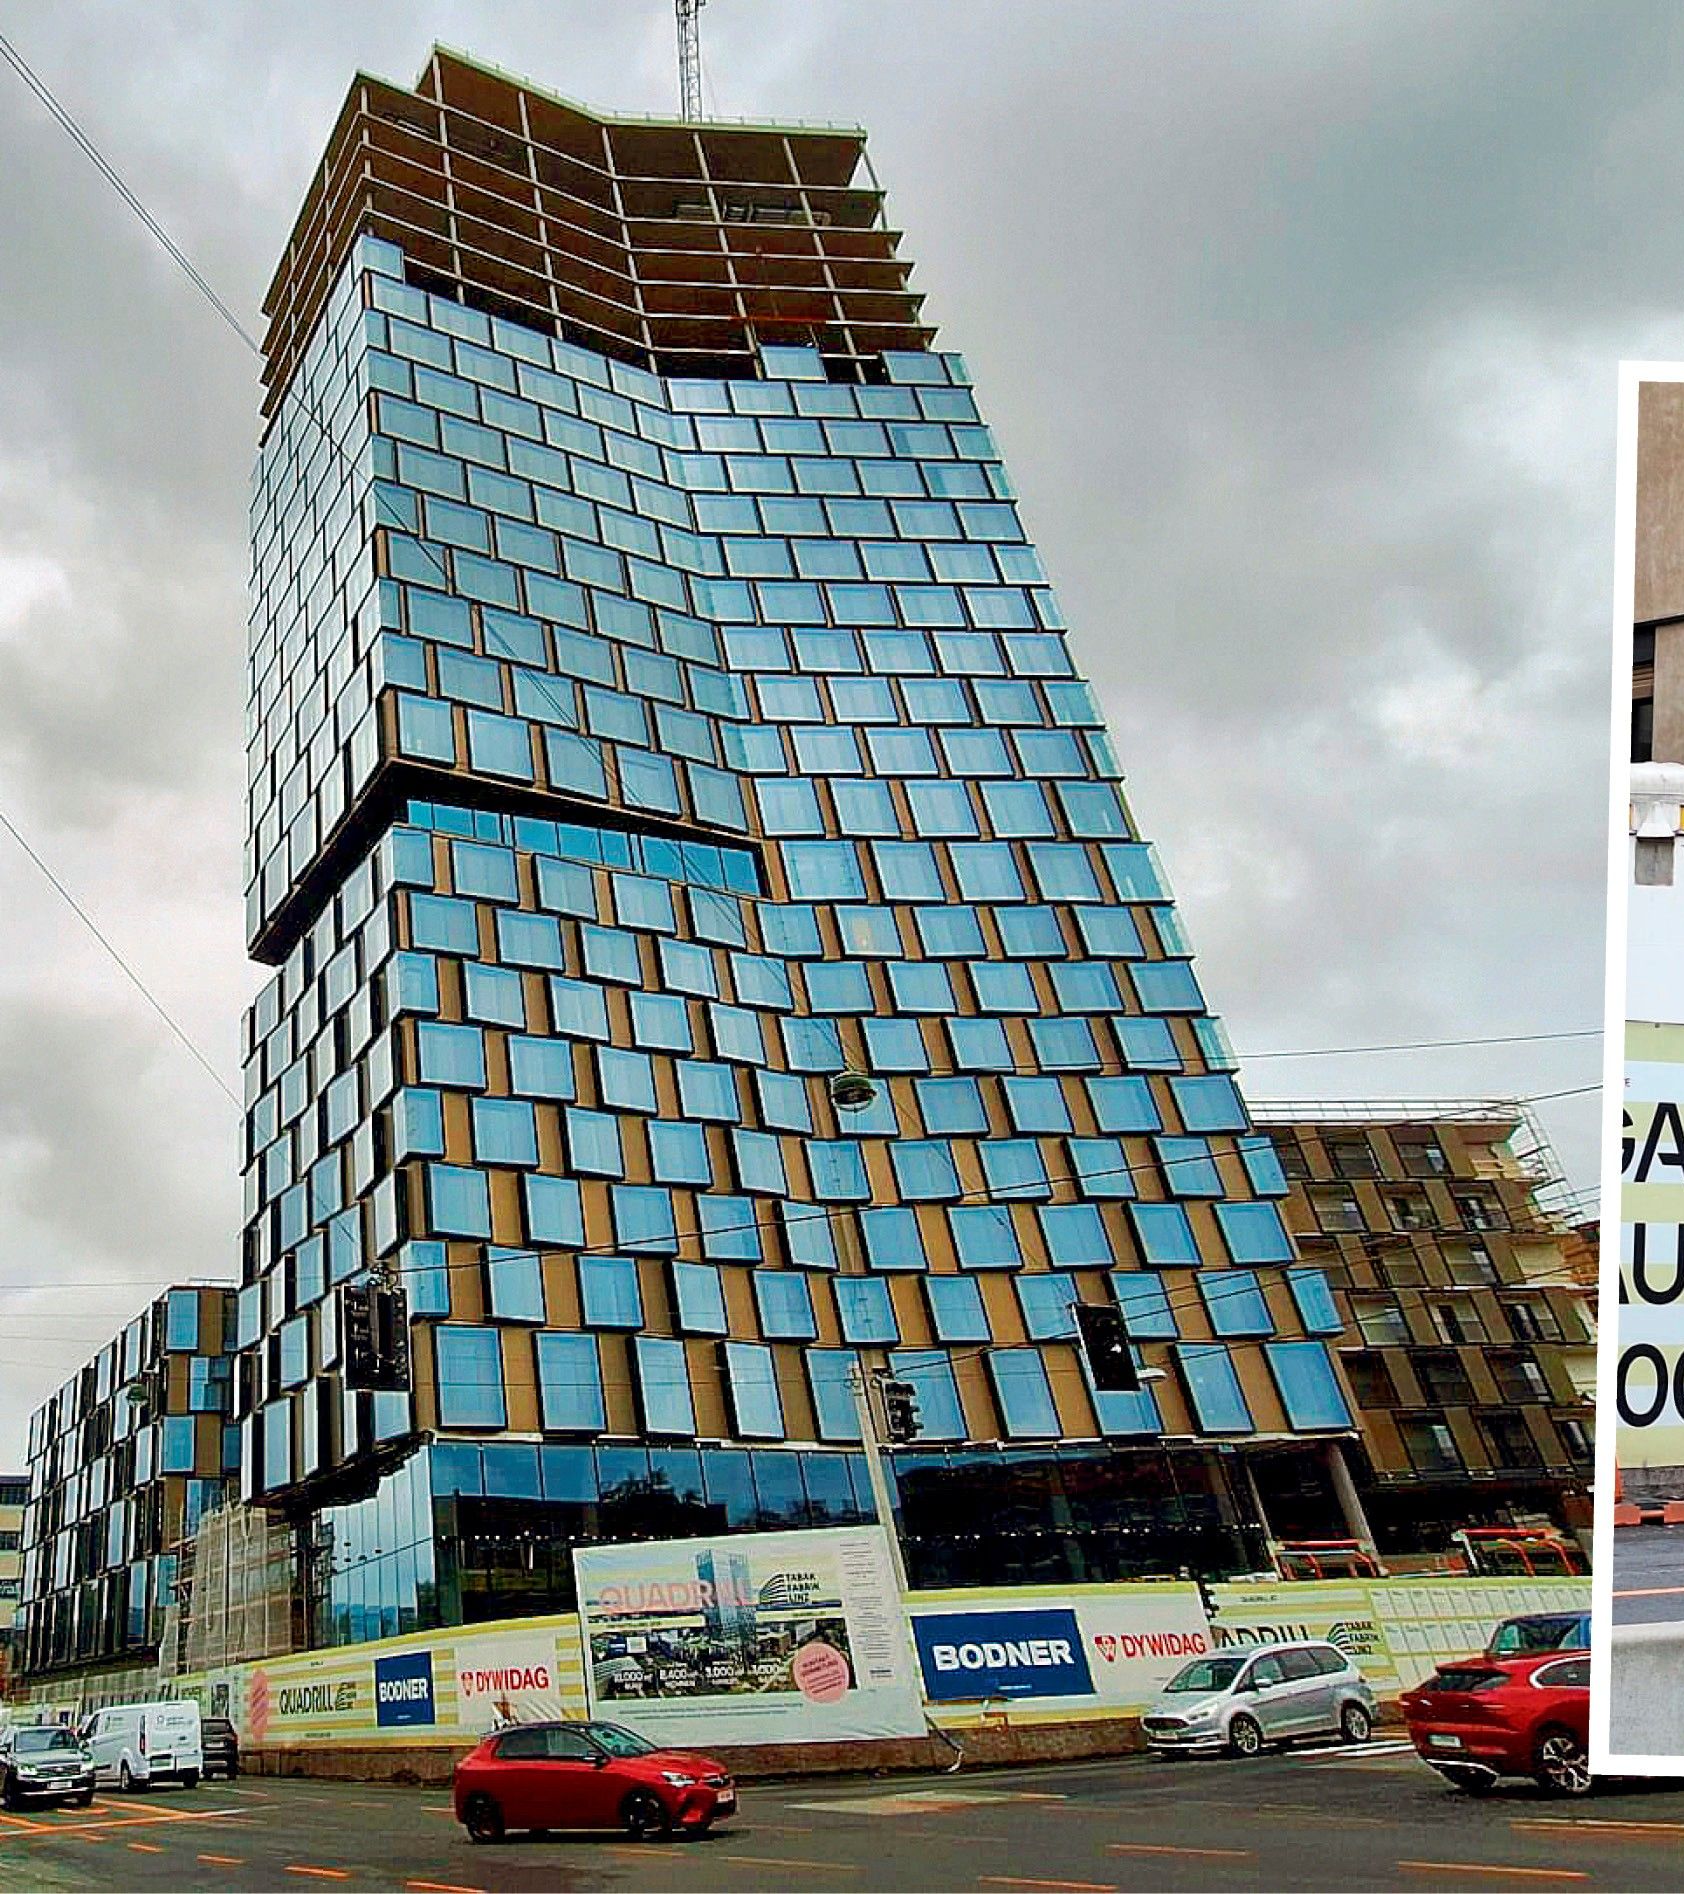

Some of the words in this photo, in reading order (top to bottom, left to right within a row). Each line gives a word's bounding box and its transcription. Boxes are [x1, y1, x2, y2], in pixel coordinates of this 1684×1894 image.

[932, 1640, 1075, 1671] BODNER
[1120, 1633, 1207, 1659] DYWIDAG
[378, 1678, 428, 1703] BODNER
[475, 1667, 549, 1693] DYWIDAG
[279, 1682, 335, 1715] QUADRILL
